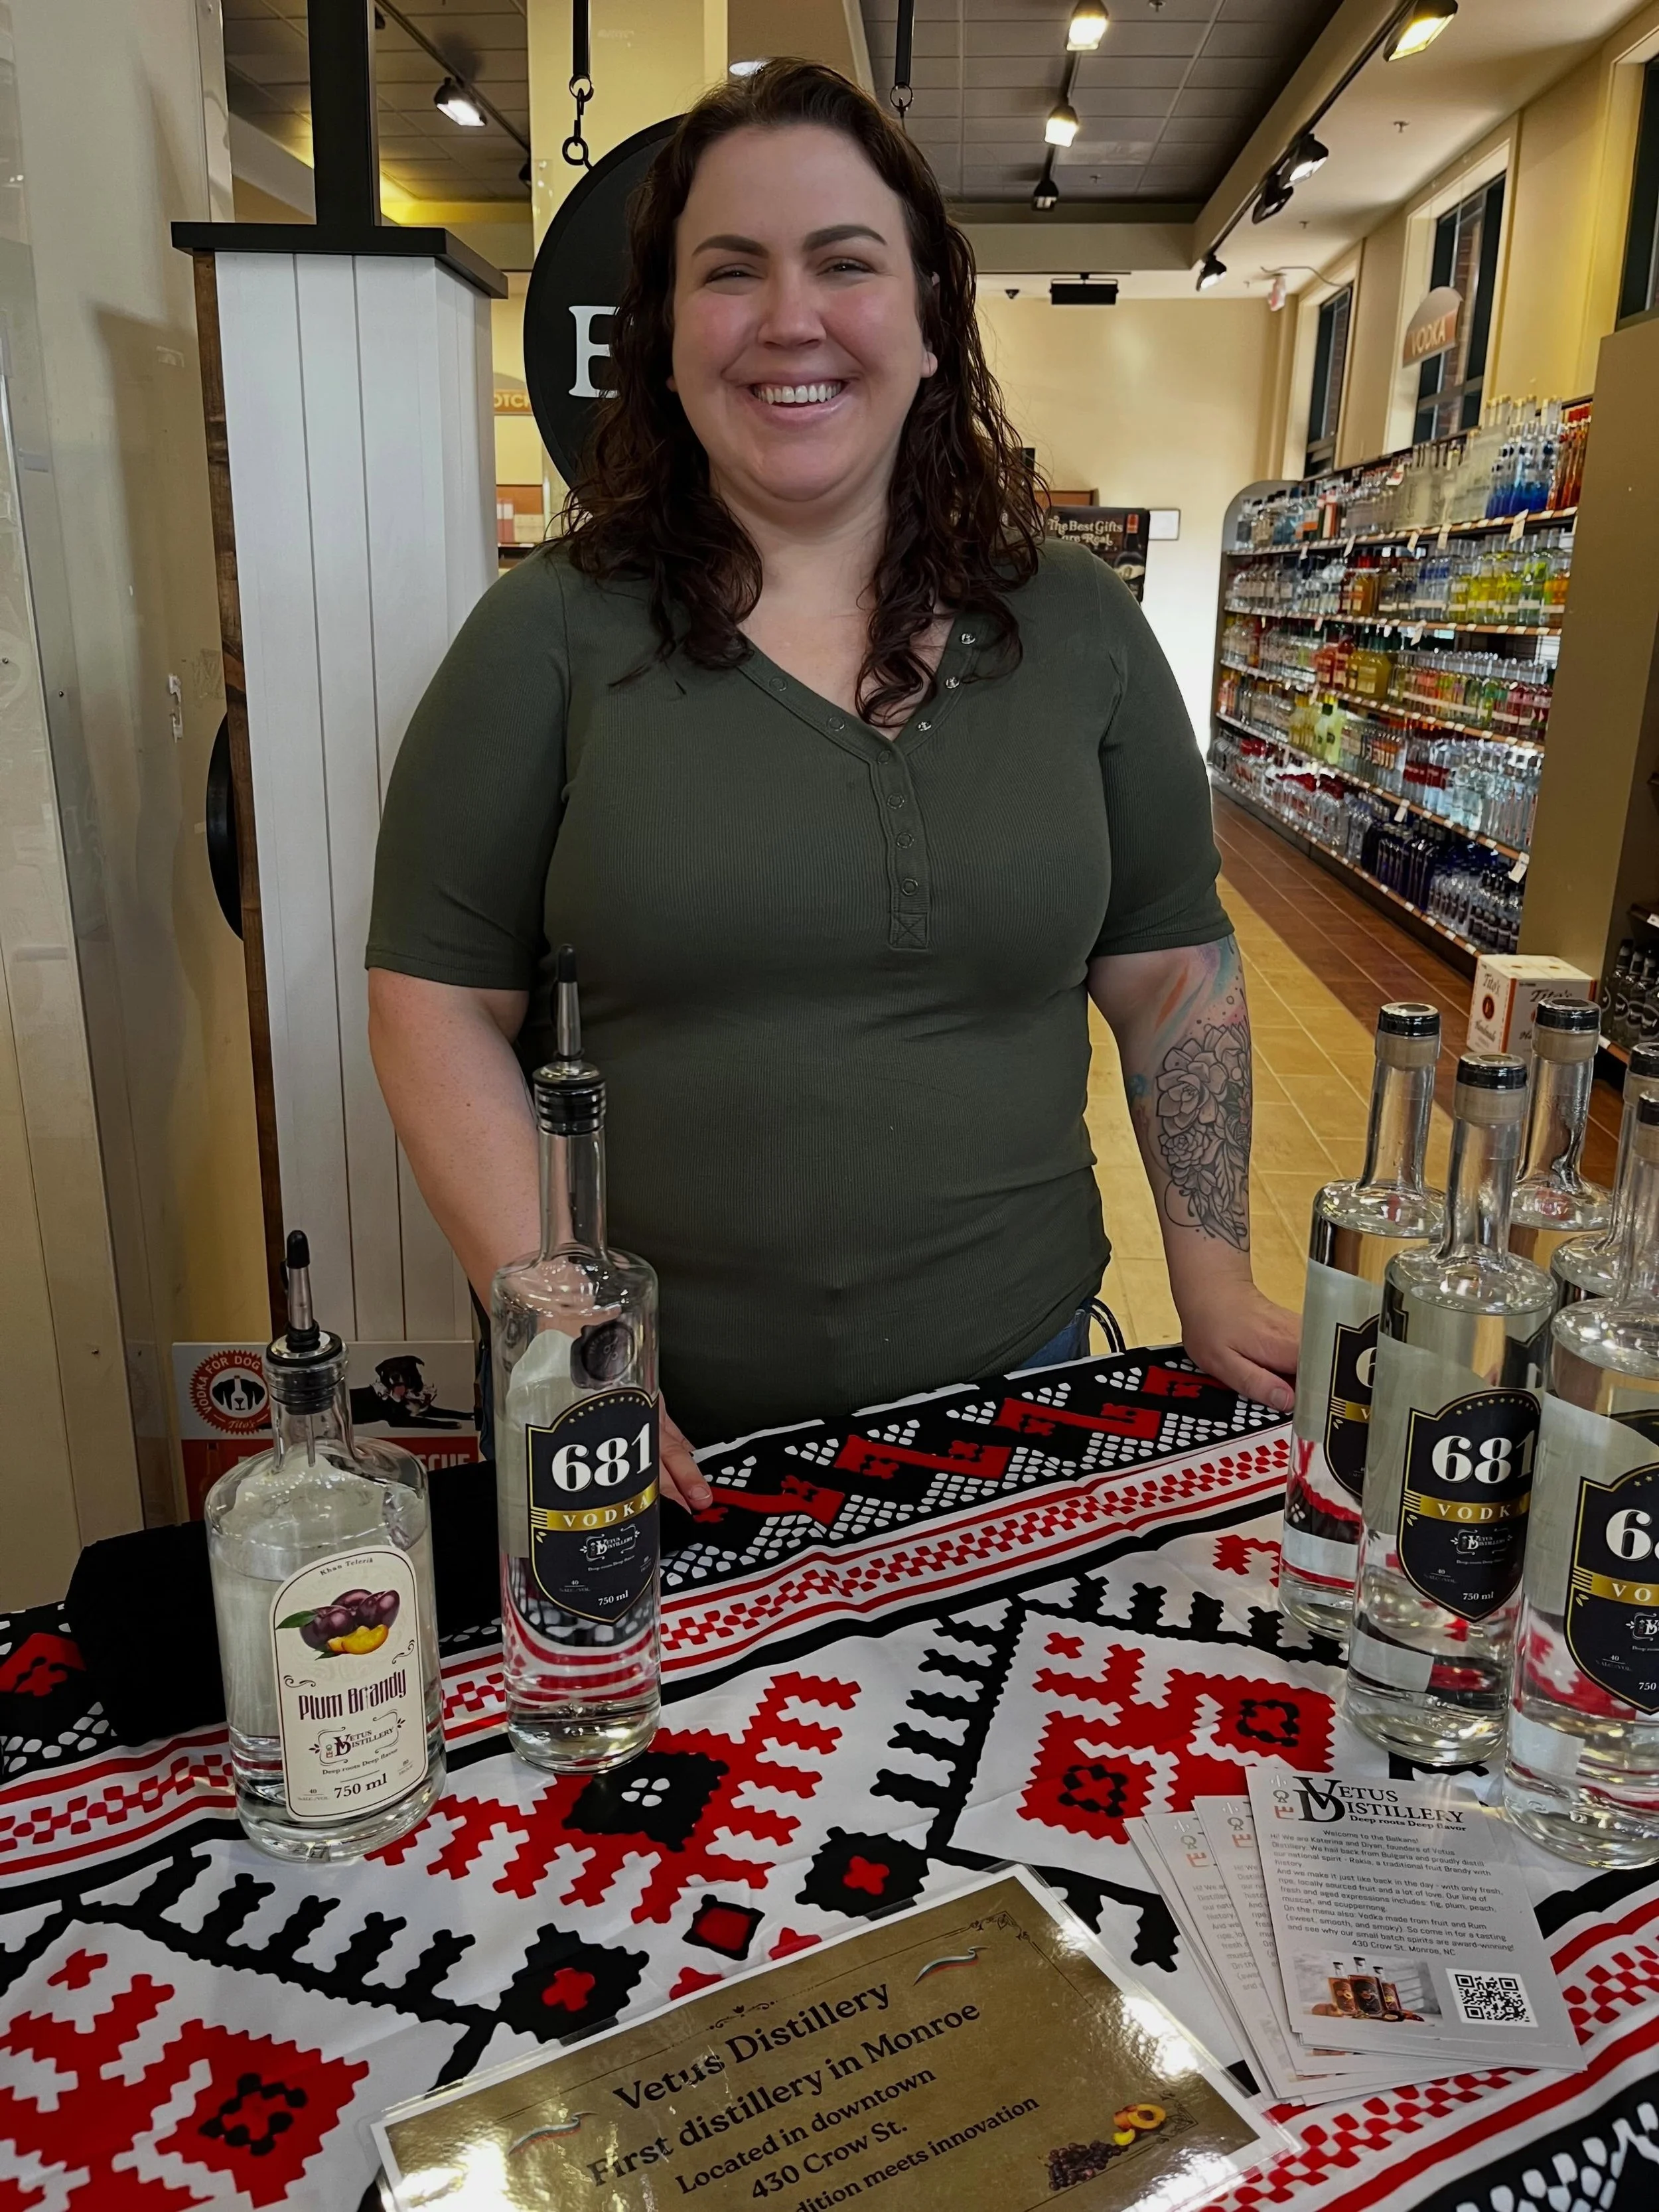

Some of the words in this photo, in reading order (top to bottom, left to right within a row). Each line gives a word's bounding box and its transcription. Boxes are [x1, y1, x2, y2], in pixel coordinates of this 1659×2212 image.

[1047, 515, 1068, 535] The
[1069, 520, 1094, 532] Best
[1095, 520, 1123, 535] Gifts
[196, 1376, 212, 1414] VODKA
[205, 1357, 229, 1374] FOR
[234, 1355, 261, 1370] DOG
[551, 1422, 654, 1493] 681
[1431, 1430, 1535, 1485] 681
[562, 1496, 650, 1528] VODKA
[1437, 1503, 1511, 1520] VODK
[598, 1595, 614, 1606] 750
[616, 1589, 628, 1601] ml
[1481, 1591, 1494, 1600] ml
[299, 1694, 343, 1720] Plum
[348, 1668, 407, 1714] Brandy
[1638, 1682, 1657, 1691] 750
[362, 1757, 379, 1767] Deep
[334, 1783, 362, 1799] 750
[366, 1773, 388, 1791] ml
[1293, 1789, 1464, 1823] DISTILLERY
[1350, 1815, 1376, 1824] Deep
[1408, 1820, 1434, 1829] Deep
[1323, 1830, 1358, 1839] Welcome
[1386, 1836, 1418, 1844] Balkans!
[1386, 1844, 1420, 1853] founders
[1288, 1852, 1319, 1860] national
[1349, 1857, 1374, 1866] Rakia,
[1383, 1862, 1423, 1870] traditional
[1444, 1866, 1471, 1876] Brandy
[1382, 1852, 1413, 1861] Bulgaria
[1431, 1857, 1460, 1866] proudly
[1461, 1859, 1484, 1868] distill
[1297, 1879, 1323, 1888] locally
[1326, 1882, 1357, 1891] sourced
[1320, 1890, 1339, 1899] aged
[1341, 1893, 1390, 1903] expressions
[1358, 1912, 1383, 1921] Vodka
[1321, 1927, 1338, 1936] why
[1381, 1933, 1405, 1942] batch
[1407, 1937, 1433, 1945] spirits
[1452, 1941, 1514, 1952] award-winning!
[1370, 1941, 1392, 1950] Crow
[1476, 1933, 1506, 1942] tasting
[613, 2051, 725, 2110] Vetus
[725, 1984, 890, 2063] Distillery
[586, 2137, 673, 2187] First
[679, 2069, 822, 2148] distillery
[824, 2057, 863, 2080] in
[861, 2004, 981, 2063] Monroe
[674, 2134, 781, 2195] Located
[779, 2125, 810, 2147] in
[811, 2069, 937, 2134] downtown
[751, 2165, 800, 2200] 430
[802, 2136, 869, 2174] Crow
[874, 2120, 909, 2144] St.
[796, 2182, 863, 2212] dition
[863, 2148, 929, 2189] meets
[927, 2096, 1041, 2157] innovation
